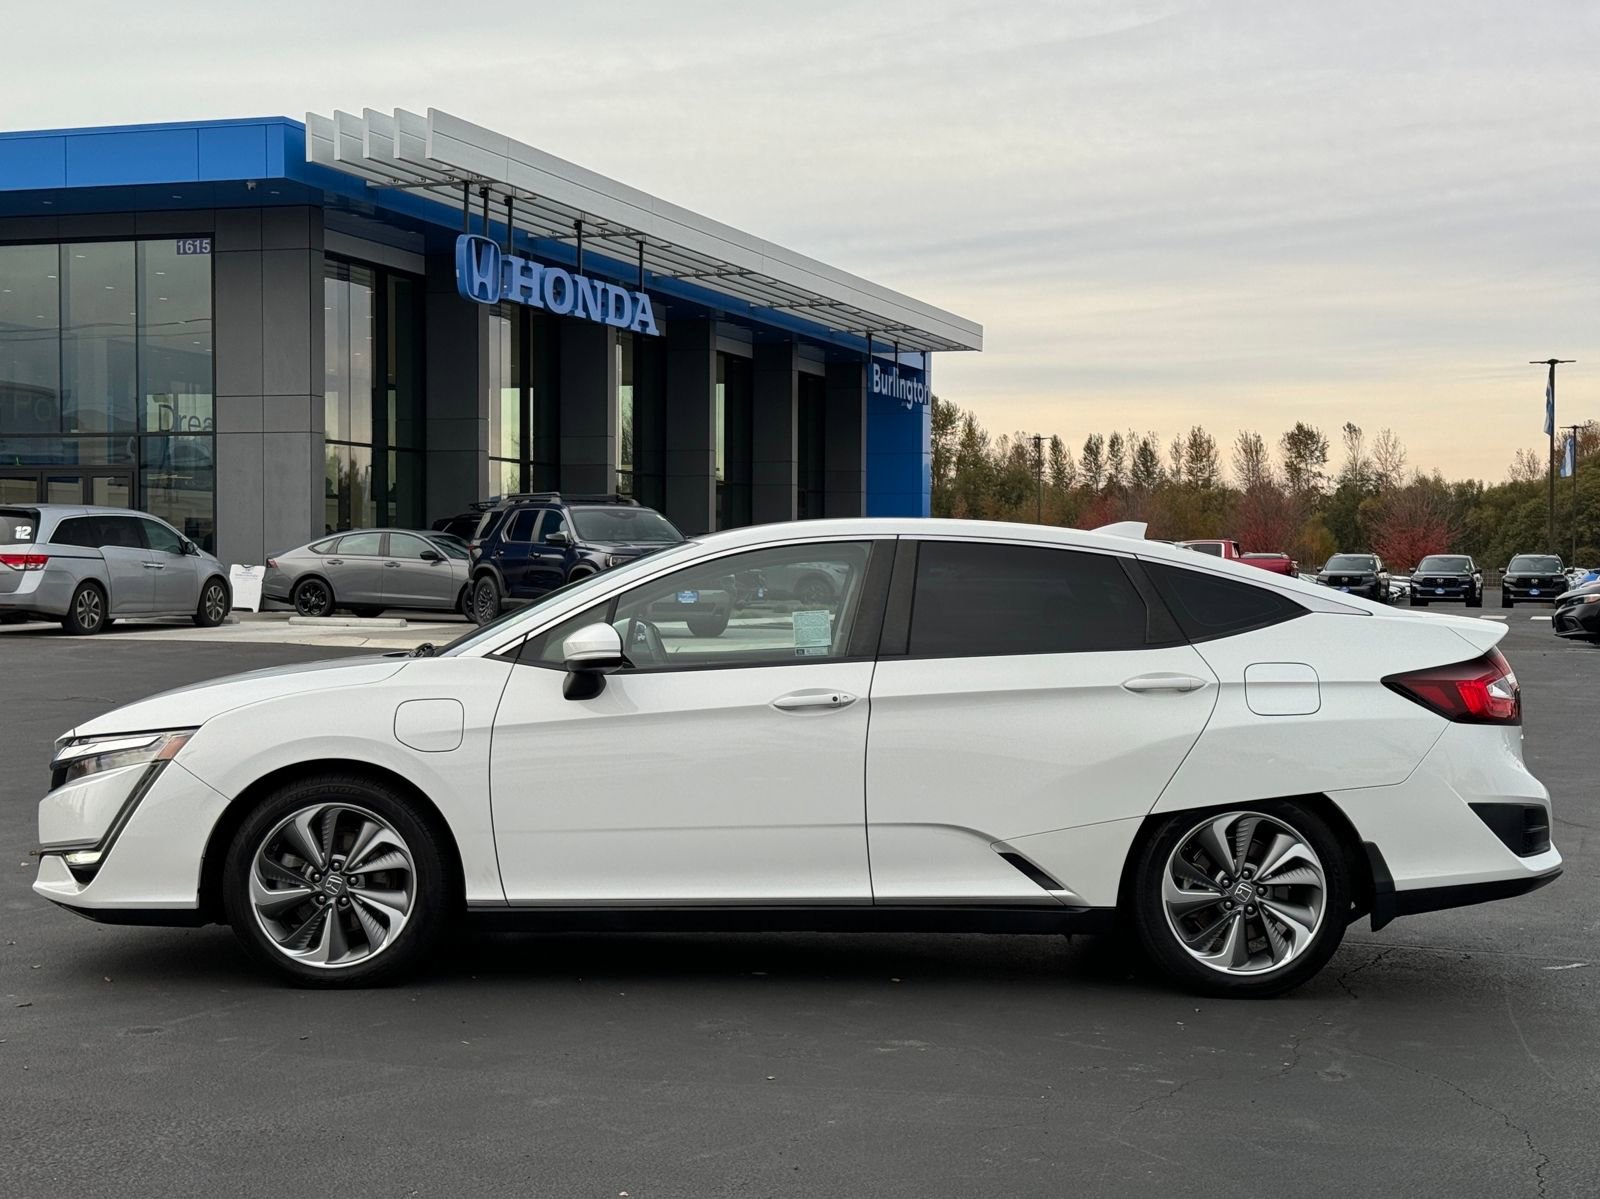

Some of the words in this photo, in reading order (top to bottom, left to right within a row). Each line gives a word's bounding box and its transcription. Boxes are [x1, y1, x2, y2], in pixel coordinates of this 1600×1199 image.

[177, 239, 211, 254] 1615
[501, 254, 660, 336] HONDA
[873, 363, 930, 410] Burlington
[15, 525, 32, 540] 12
